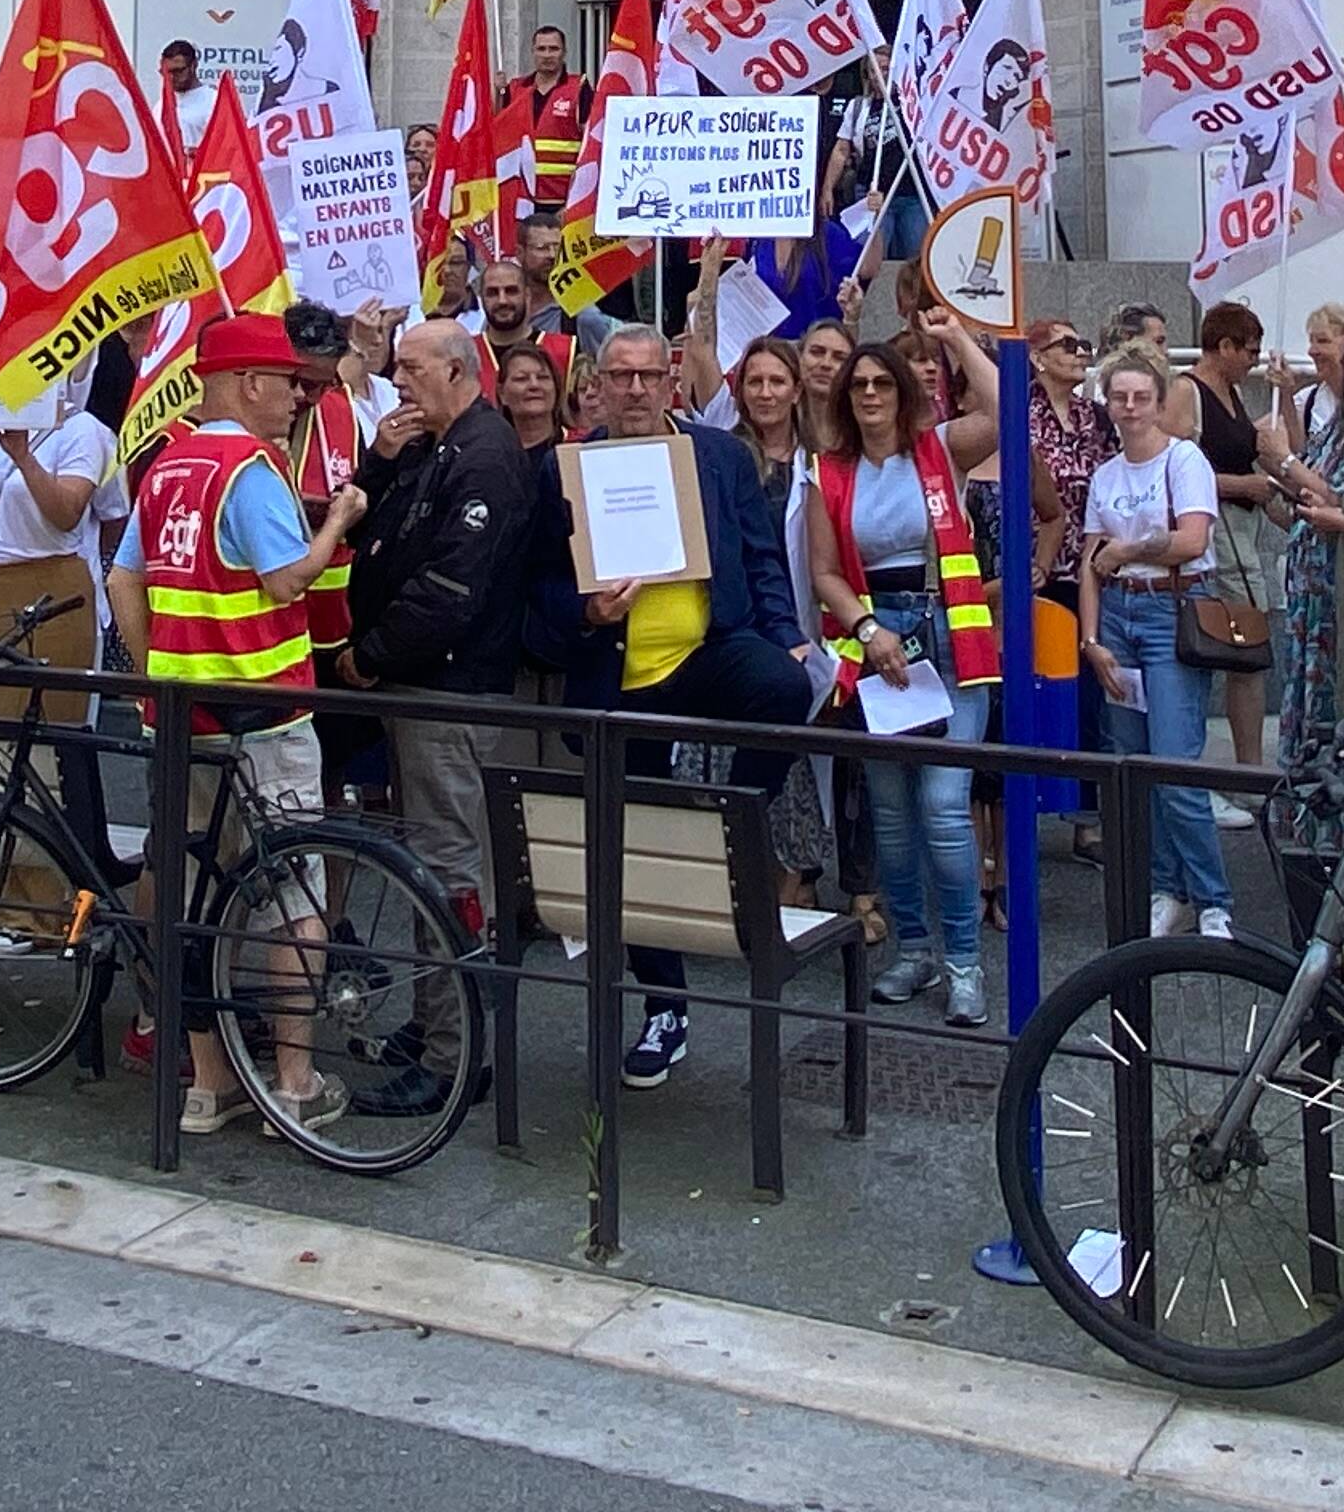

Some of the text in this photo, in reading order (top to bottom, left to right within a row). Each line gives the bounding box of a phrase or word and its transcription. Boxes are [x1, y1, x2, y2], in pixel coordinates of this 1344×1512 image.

[624, 107, 805, 138] LA PEUR NE SOIGNE PAS
[620, 138, 804, 161] NE RESTONS PLUS MUETS
[939, 106, 1010, 181] USD
[302, 150, 394, 177] SOIGNANTS
[301, 170, 397, 201] MALTRAITÉS
[718, 167, 801, 194] ENFANTS
[316, 196, 392, 223] ENFANTS
[689, 188, 812, 219] MÉRITENT MIEUX!
[305, 218, 405, 249] EN DANGER
